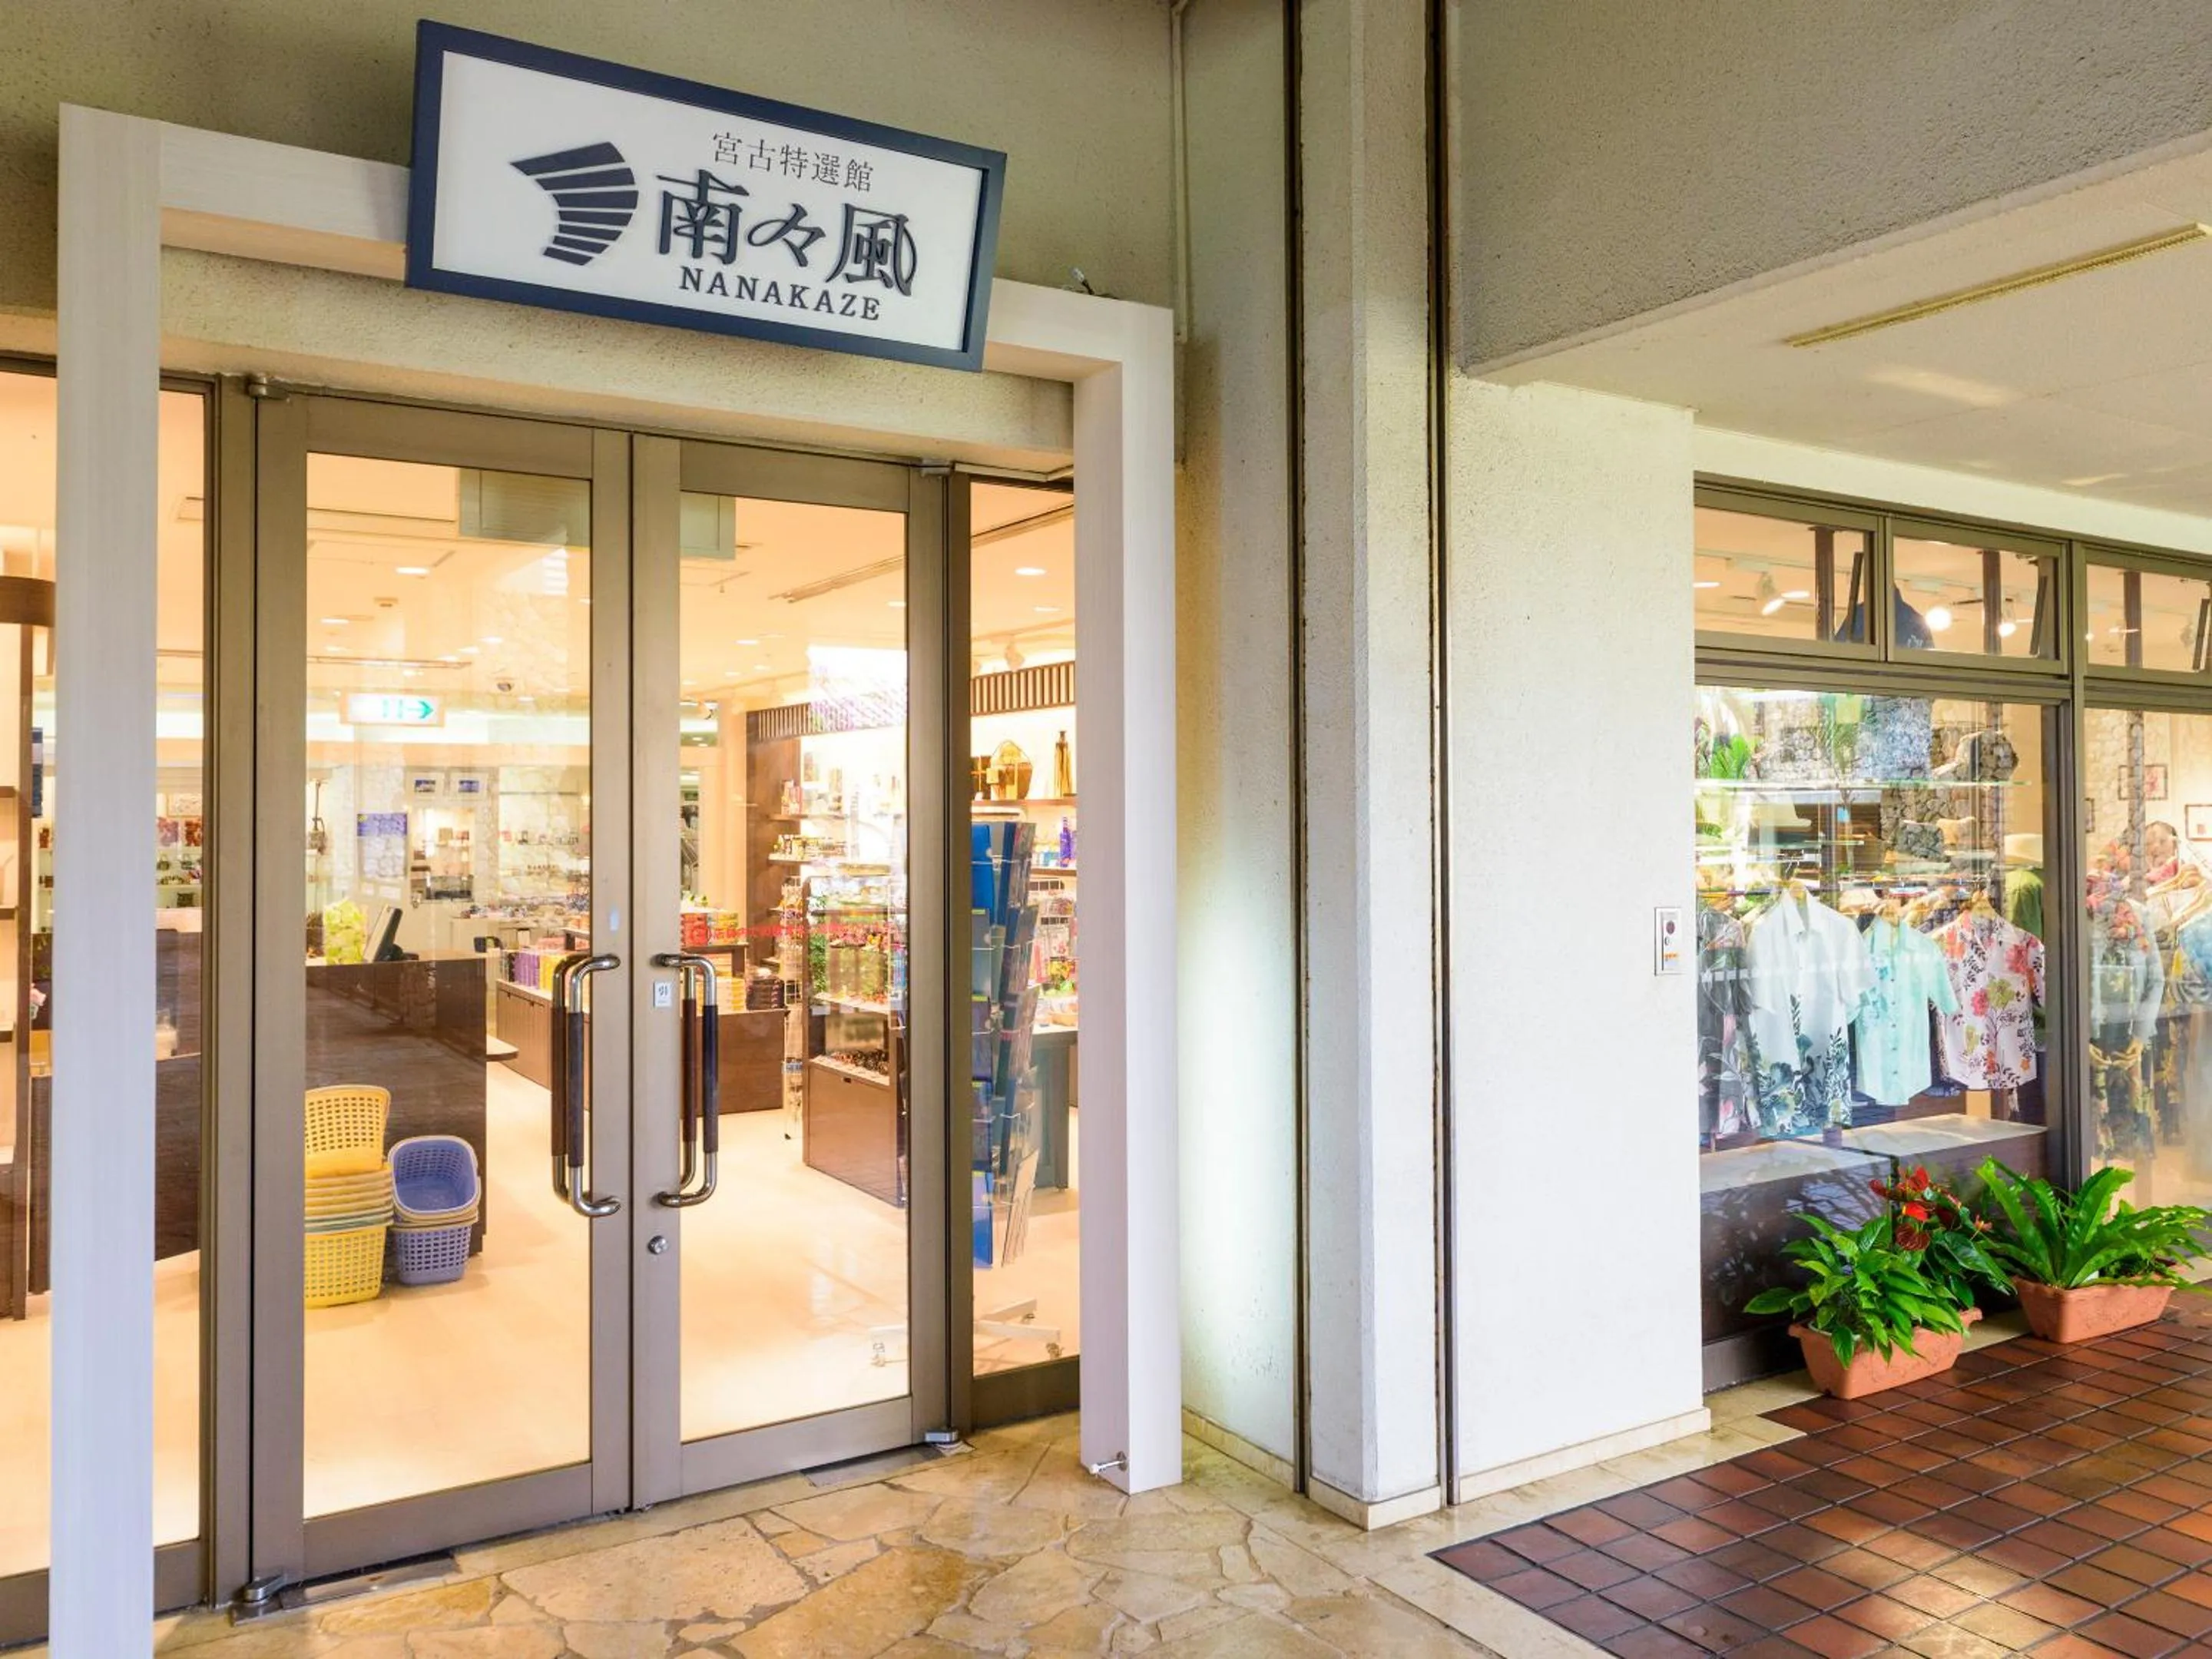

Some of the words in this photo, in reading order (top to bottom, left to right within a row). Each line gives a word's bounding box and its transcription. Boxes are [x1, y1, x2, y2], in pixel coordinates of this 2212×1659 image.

[713, 131, 874, 192] 宮古特選館
[656, 169, 918, 296] 南々風
[679, 266, 881, 320] NANAKAZE
